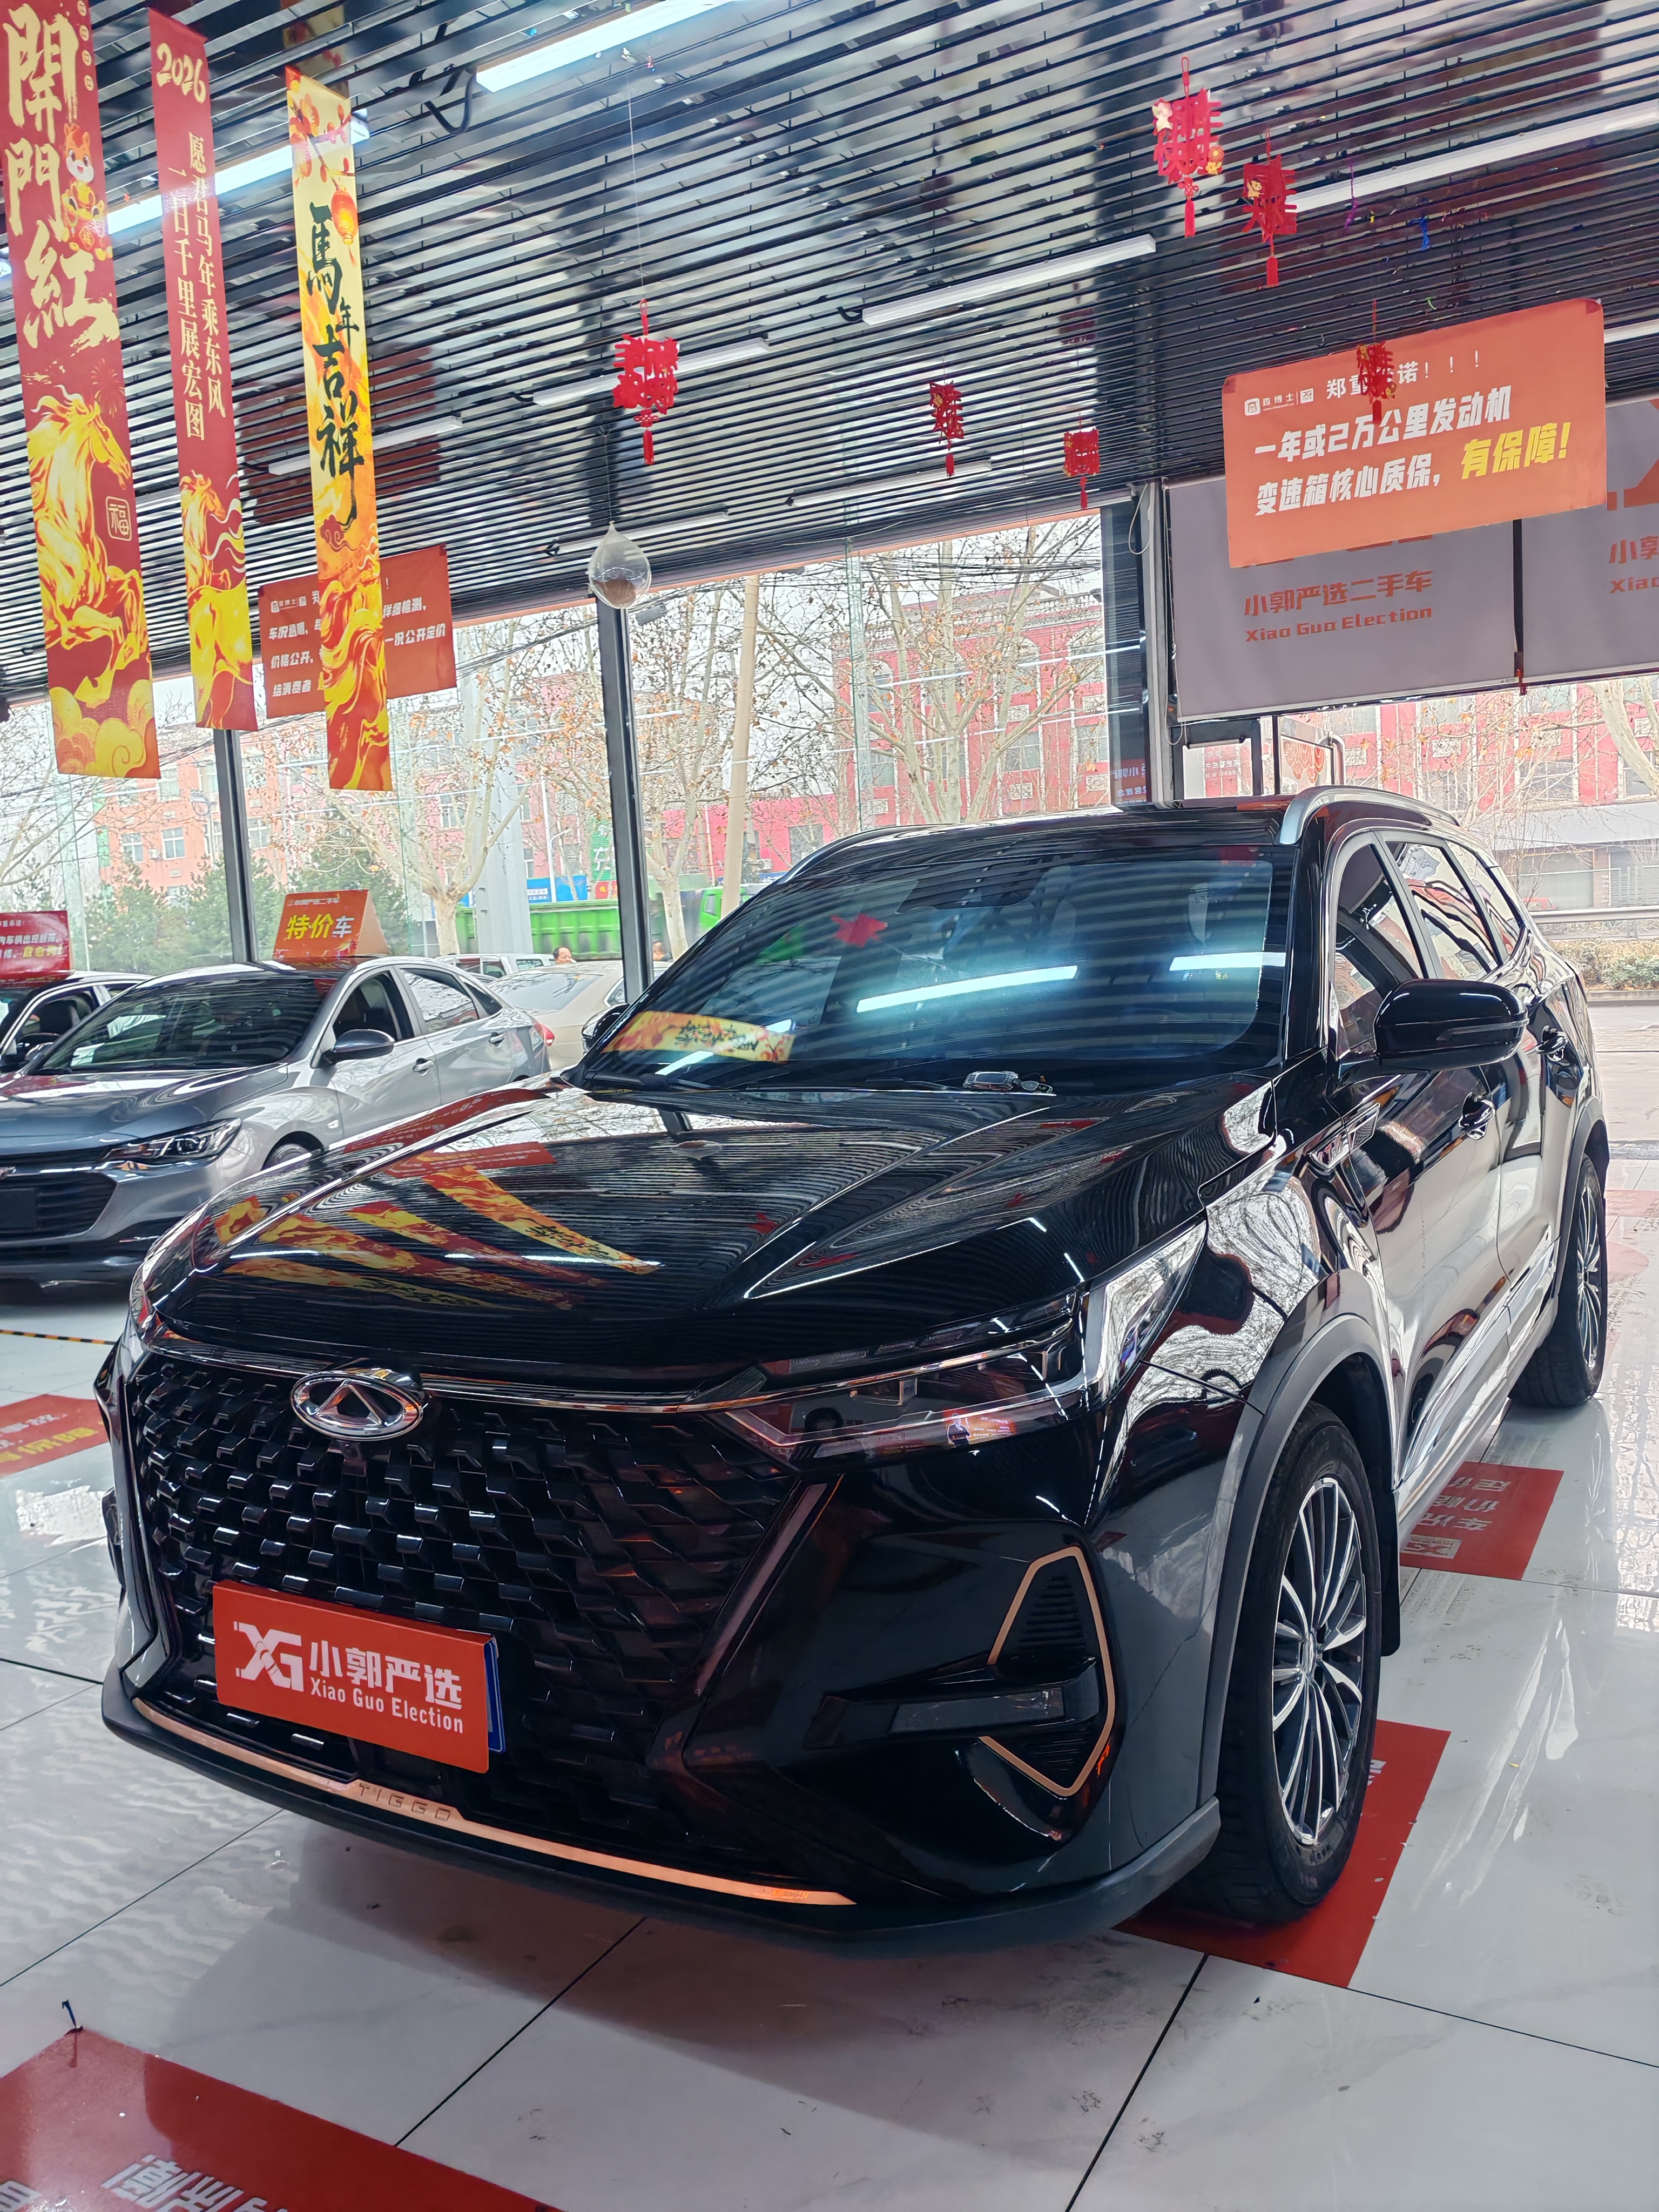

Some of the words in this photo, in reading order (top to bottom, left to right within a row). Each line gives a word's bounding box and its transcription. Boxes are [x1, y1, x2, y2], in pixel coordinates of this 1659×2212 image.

[156, 43, 206, 104] 2026
[3, 3, 120, 356] 開門紅
[167, 167, 204, 440] 一日千里展宏图
[306, 202, 364, 531] 馬年吉祥
[1255, 385, 1512, 462] 一年或2万公里发动机
[1255, 453, 1441, 516] 变速箱核心质保，
[1461, 422, 1572, 480] 有保障！
[110, 503, 130, 536] 福
[1243, 570, 1433, 616] 小郭严选二手车
[1245, 622, 1290, 642] Xiao
[1297, 617, 1336, 636] Guo
[1341, 606, 1433, 629] Election
[272, 679, 312, 697] 给消费者
[286, 913, 355, 940] 特价车
[309, 1640, 463, 1710] 小郭严选
[310, 1676, 346, 1703] Xiao
[353, 1688, 385, 1714] Guo
[392, 1697, 464, 1735] Election
[358, 1783, 451, 1822] TIGGO
